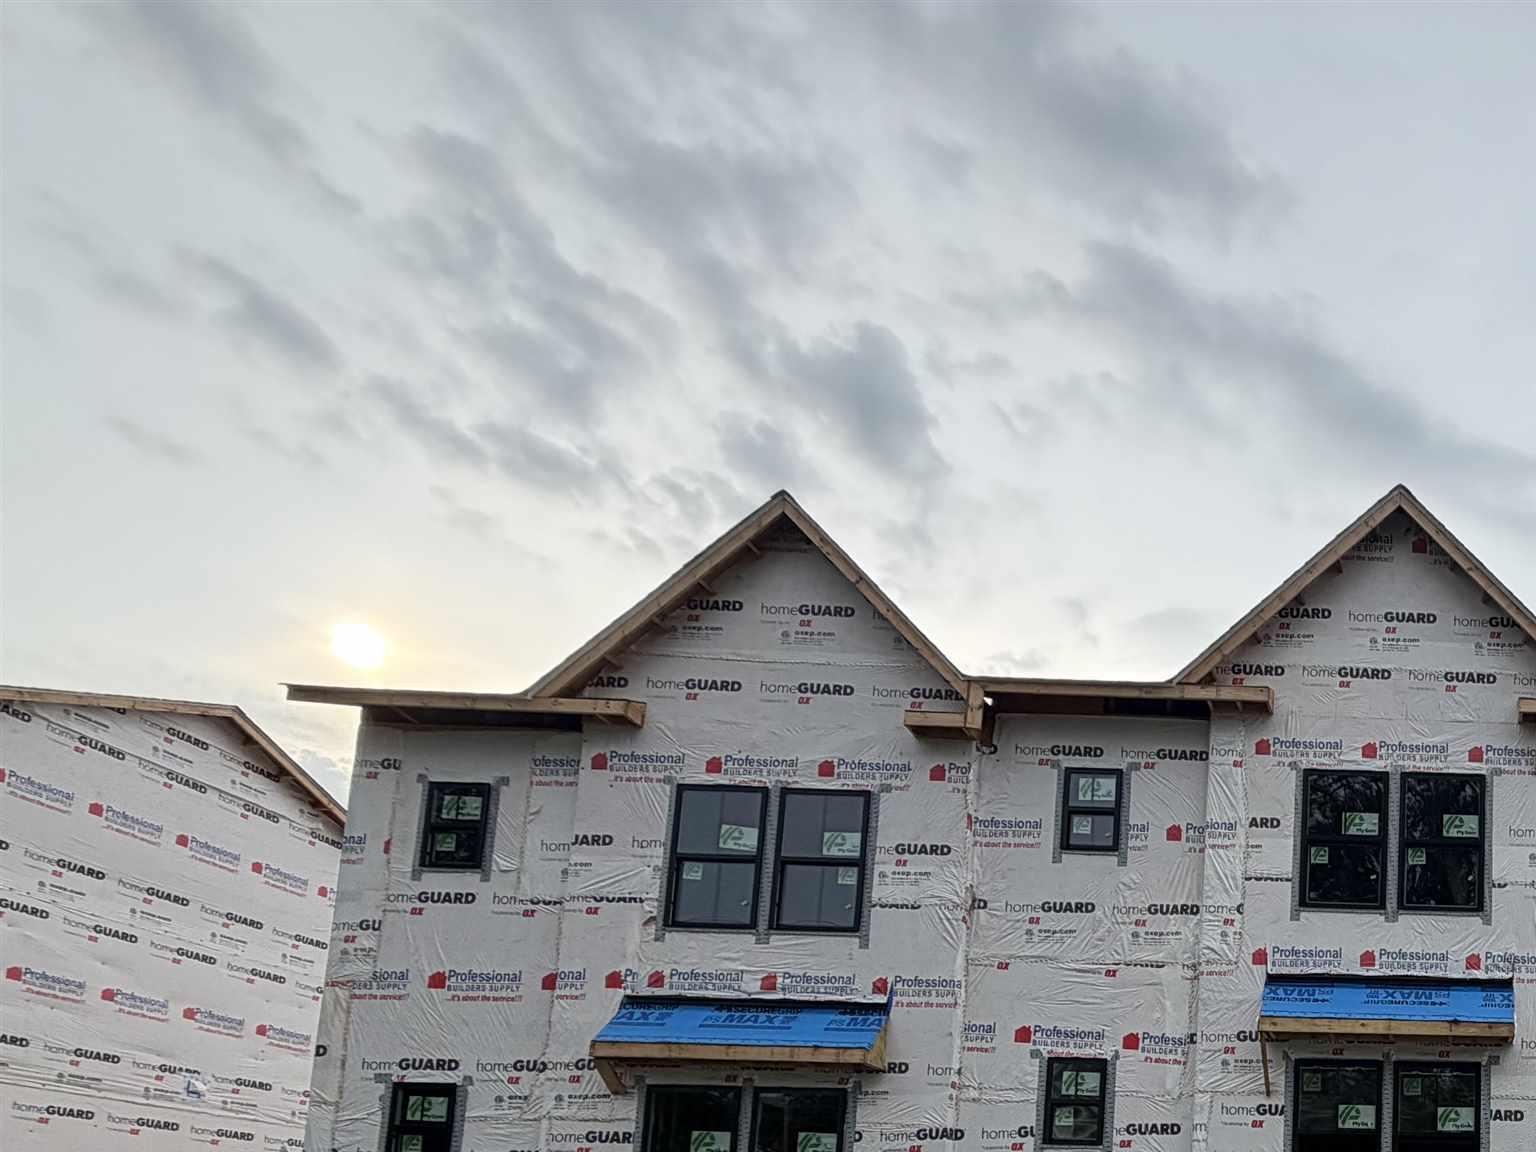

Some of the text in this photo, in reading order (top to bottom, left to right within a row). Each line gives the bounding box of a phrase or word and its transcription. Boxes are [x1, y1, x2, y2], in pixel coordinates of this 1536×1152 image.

[761, 603, 855, 618] homeGUARD
[1349, 610, 1437, 625] homeGUARD
[1302, 666, 1392, 681] homeGUARD
[1408, 670, 1497, 685] homeGUARD
[646, 677, 742, 693] homeGUARD
[760, 680, 854, 696] homeGUARD
[46, 721, 126, 761] homeGUARD
[1272, 737, 1343, 751] Professional
[1379, 741, 1449, 754] Professional
[609, 751, 686, 766] Professional
[1015, 744, 1104, 758] homeGUARD
[1121, 747, 1209, 762] homeGUARD
[723, 755, 799, 769] Professional
[837, 758, 912, 773] Professional
[138, 759, 208, 794] homeGUARD
[218, 793, 280, 824] homeGUARD
[105, 805, 164, 833] Professional
[973, 817, 1042, 830] Professional
[118, 878, 190, 907] homeGUARD
[1005, 901, 1096, 914] homeGUARD
[1112, 903, 1200, 916] homeGUARD
[201, 904, 264, 930] homeGUARD
[63, 916, 138, 944] homeGUARD
[1272, 946, 1342, 959] Professional
[1379, 949, 1449, 963] Professional
[226, 961, 286, 985] homeGUARD
[448, 970, 522, 982] Professional
[669, 969, 744, 984] Professional
[116, 988, 169, 1009] Professional
[1032, 1025, 1105, 1041] Professional
[44, 1042, 120, 1064] homeGUARD
[12, 1100, 95, 1120] homeGUARD
[107, 1113, 179, 1131] homeGUARD
